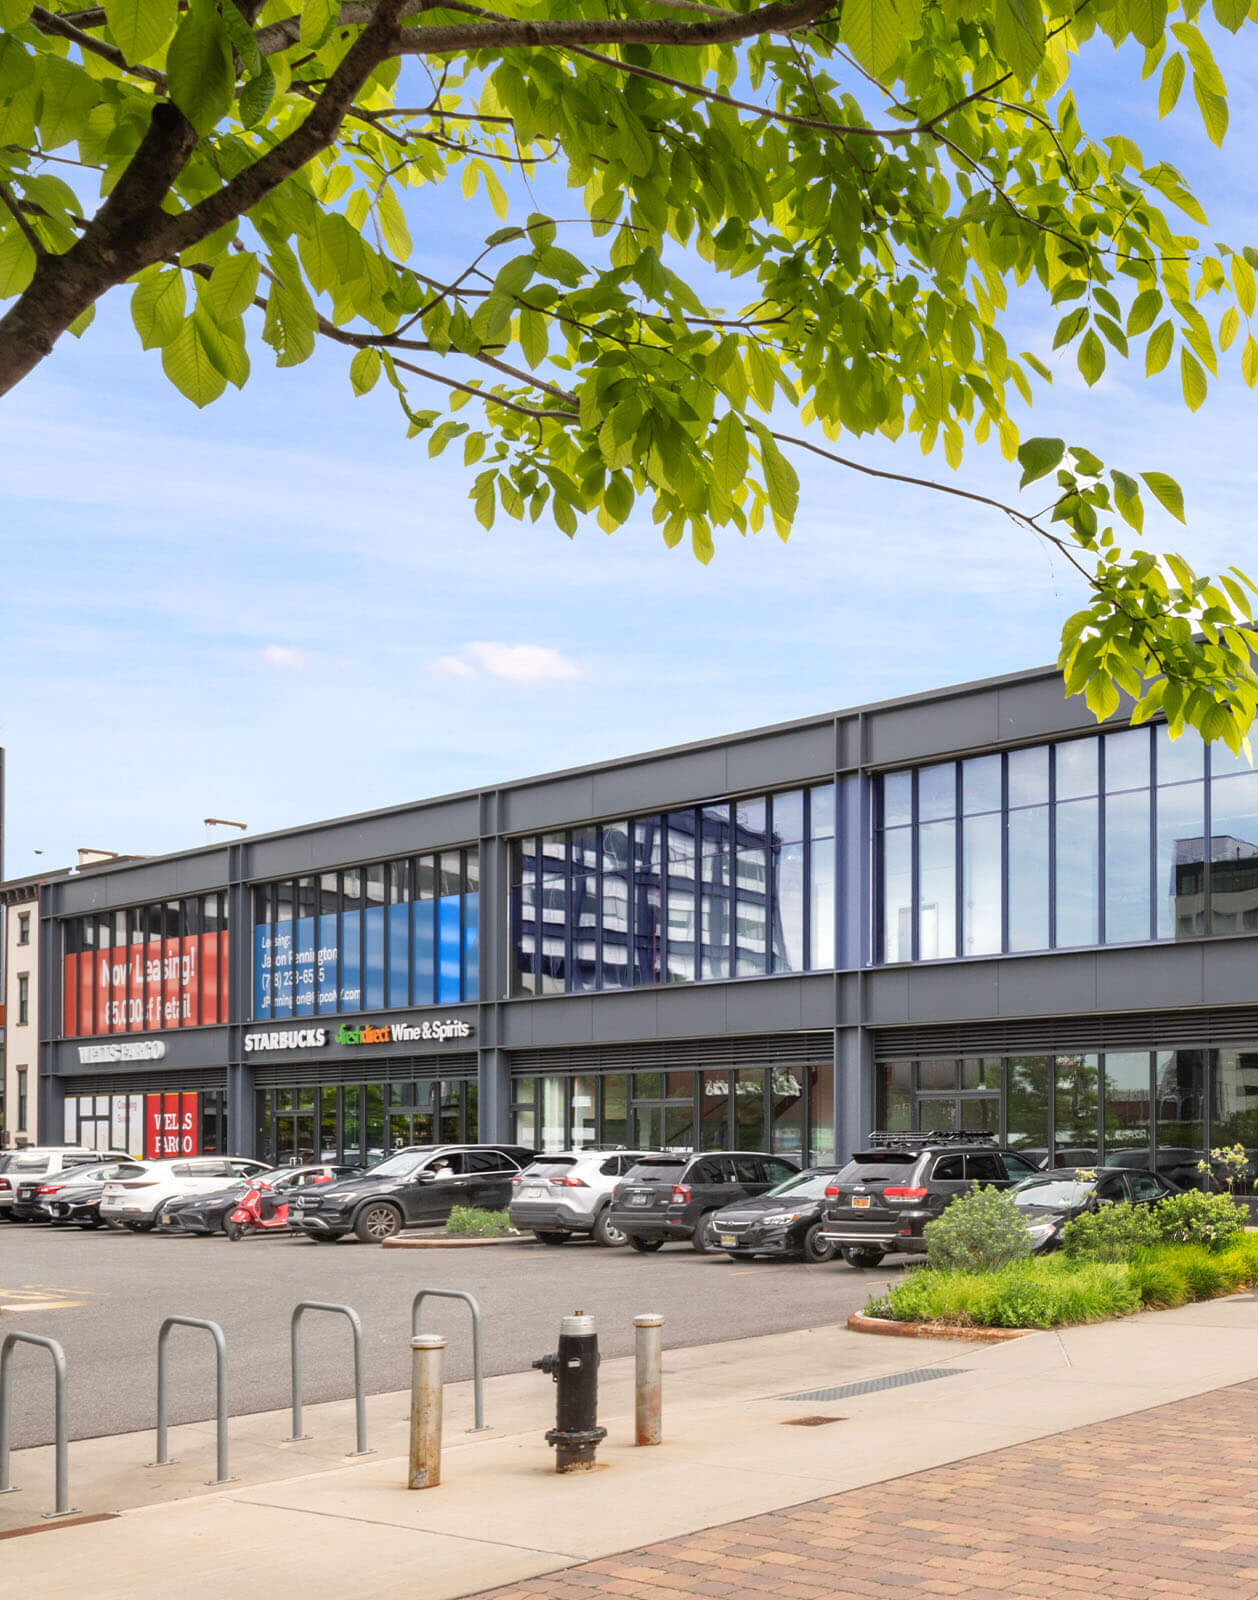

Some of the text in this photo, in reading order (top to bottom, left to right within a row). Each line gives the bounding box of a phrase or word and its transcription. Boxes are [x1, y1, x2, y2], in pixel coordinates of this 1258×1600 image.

[262, 934, 291, 949] Lesing:
[136, 946, 196, 986] Leasing!
[262, 953, 287, 969] Jaon
[262, 970, 282, 991] (78)
[244, 1028, 326, 1051] STARBUCKS
[391, 1024, 420, 1042] Wine
